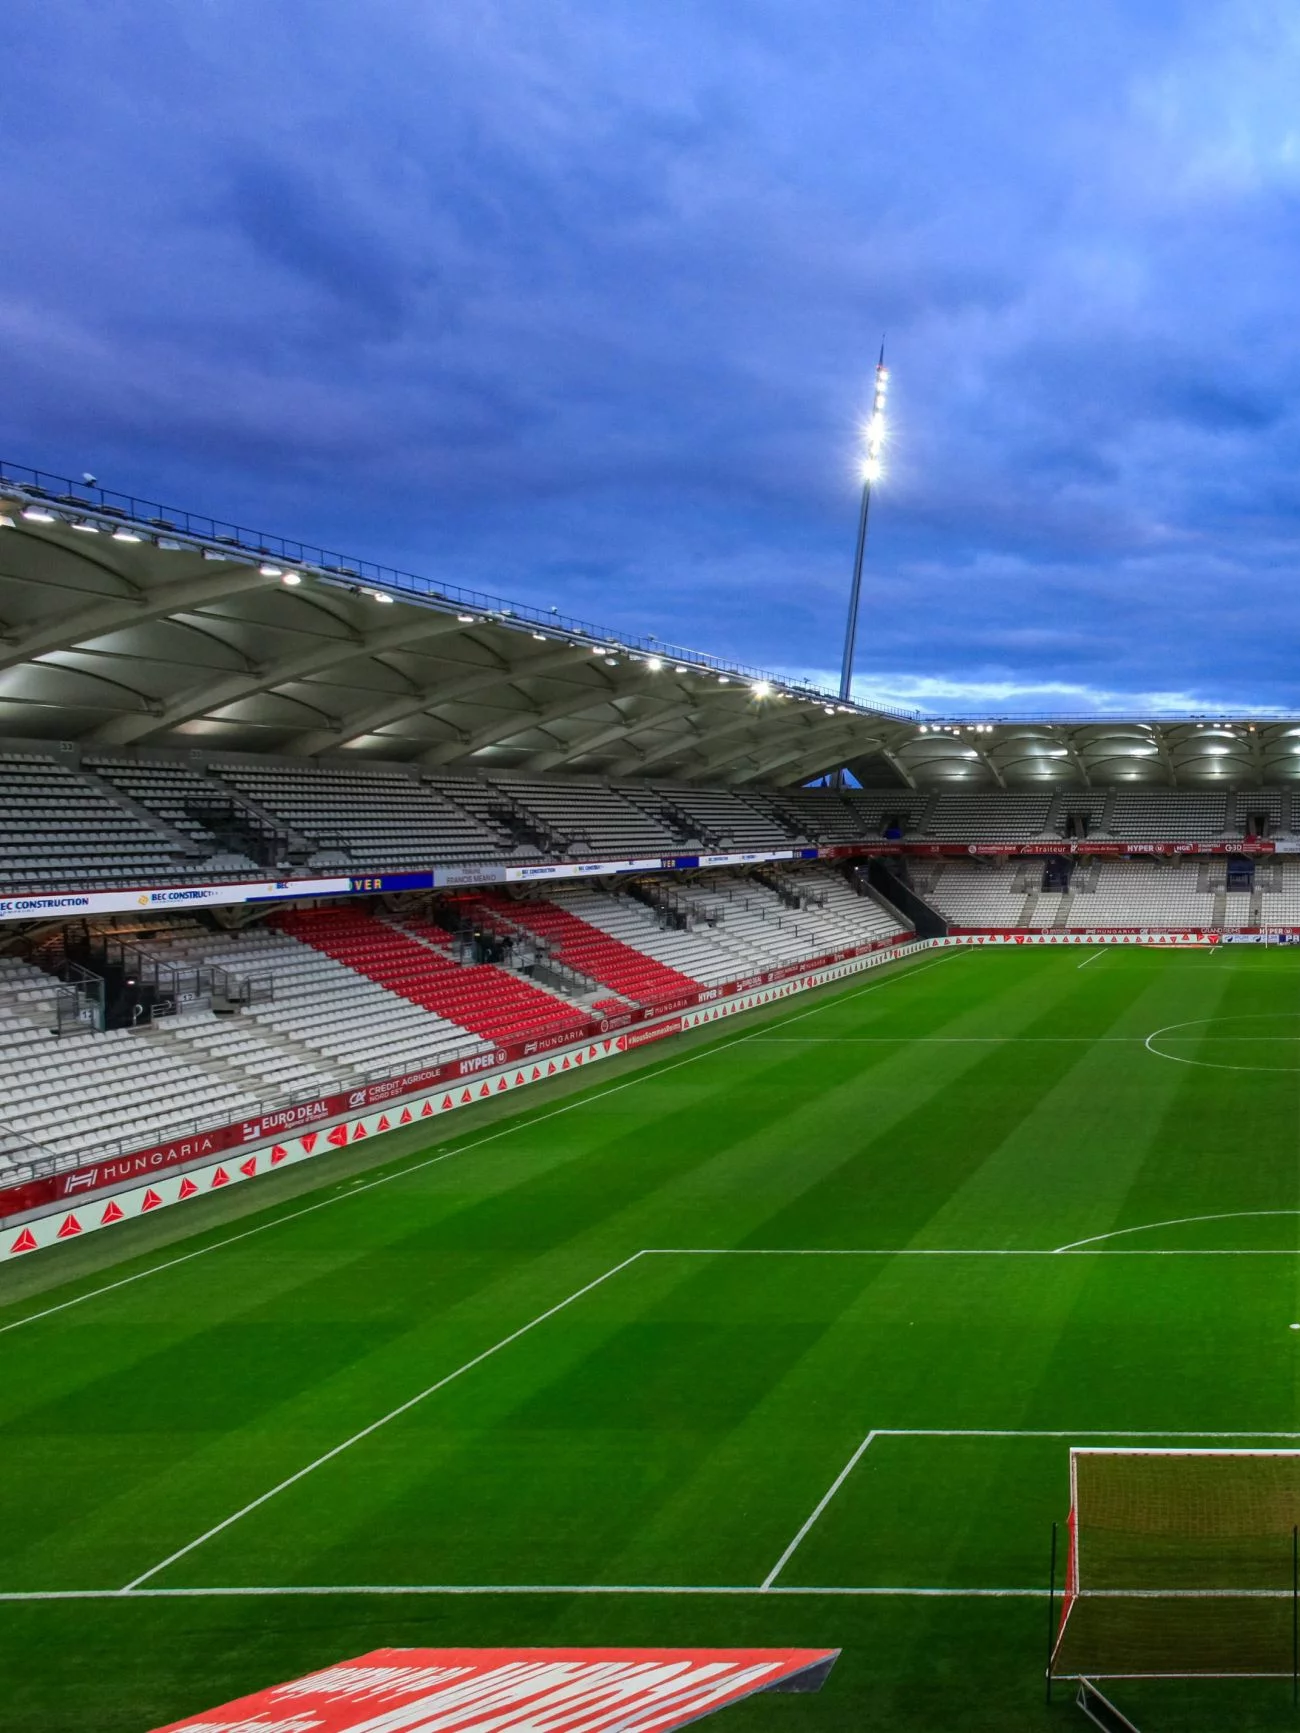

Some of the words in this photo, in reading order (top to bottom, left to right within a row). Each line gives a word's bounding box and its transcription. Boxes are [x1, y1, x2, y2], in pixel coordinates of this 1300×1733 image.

[15, 897, 89, 910] CONSTRUCTION
[151, 892, 167, 901] BEC
[539, 1030, 584, 1047] HUNGARIA
[460, 1053, 495, 1075] HYPER
[369, 1080, 400, 1097] CRÉDIT
[401, 1068, 441, 1087] AGRICOLE
[262, 1110, 295, 1130] EURO
[297, 1101, 328, 1119] DEAL
[104, 1138, 212, 1179] HUNGARIA
